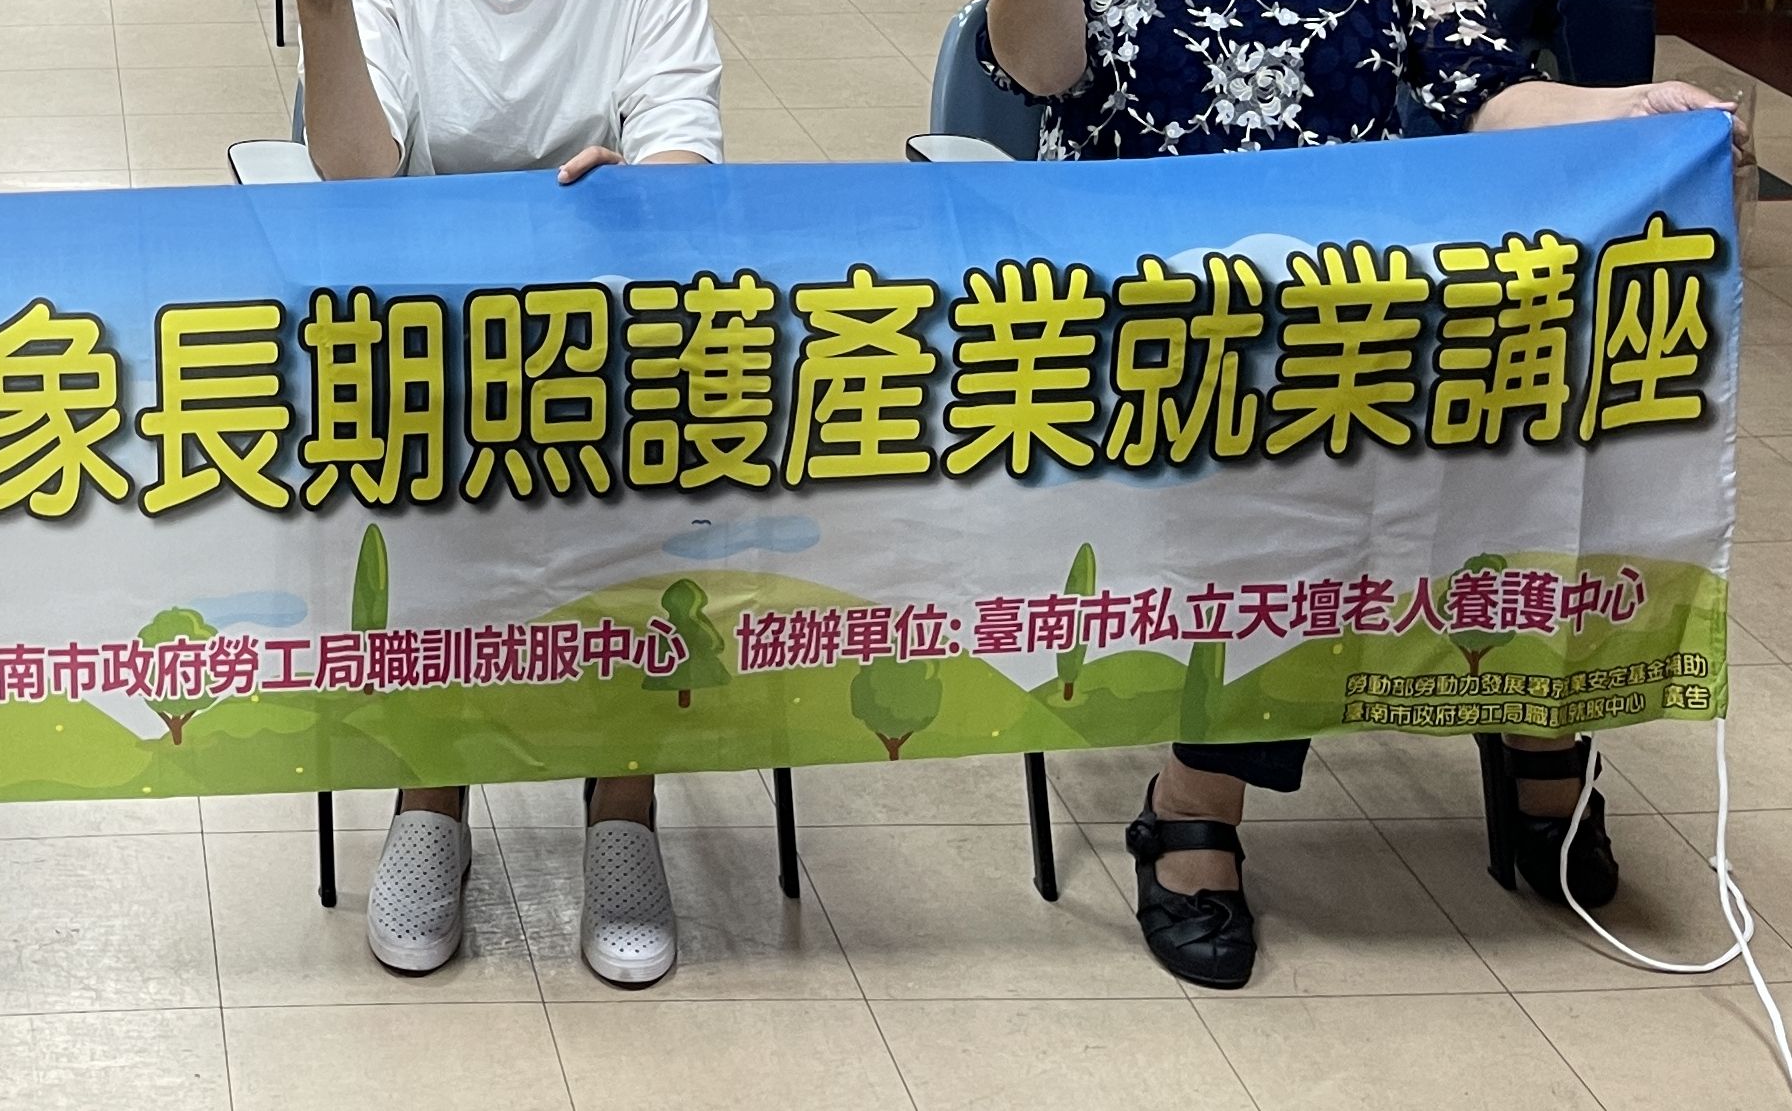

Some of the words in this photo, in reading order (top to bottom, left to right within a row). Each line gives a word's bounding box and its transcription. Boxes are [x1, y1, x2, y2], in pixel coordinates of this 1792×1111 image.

[736, 601, 962, 672] 協辦單位:
[971, 566, 1647, 656] 臺南市私立天壇老人養護中心
[1663, 683, 1711, 710] 廣告
